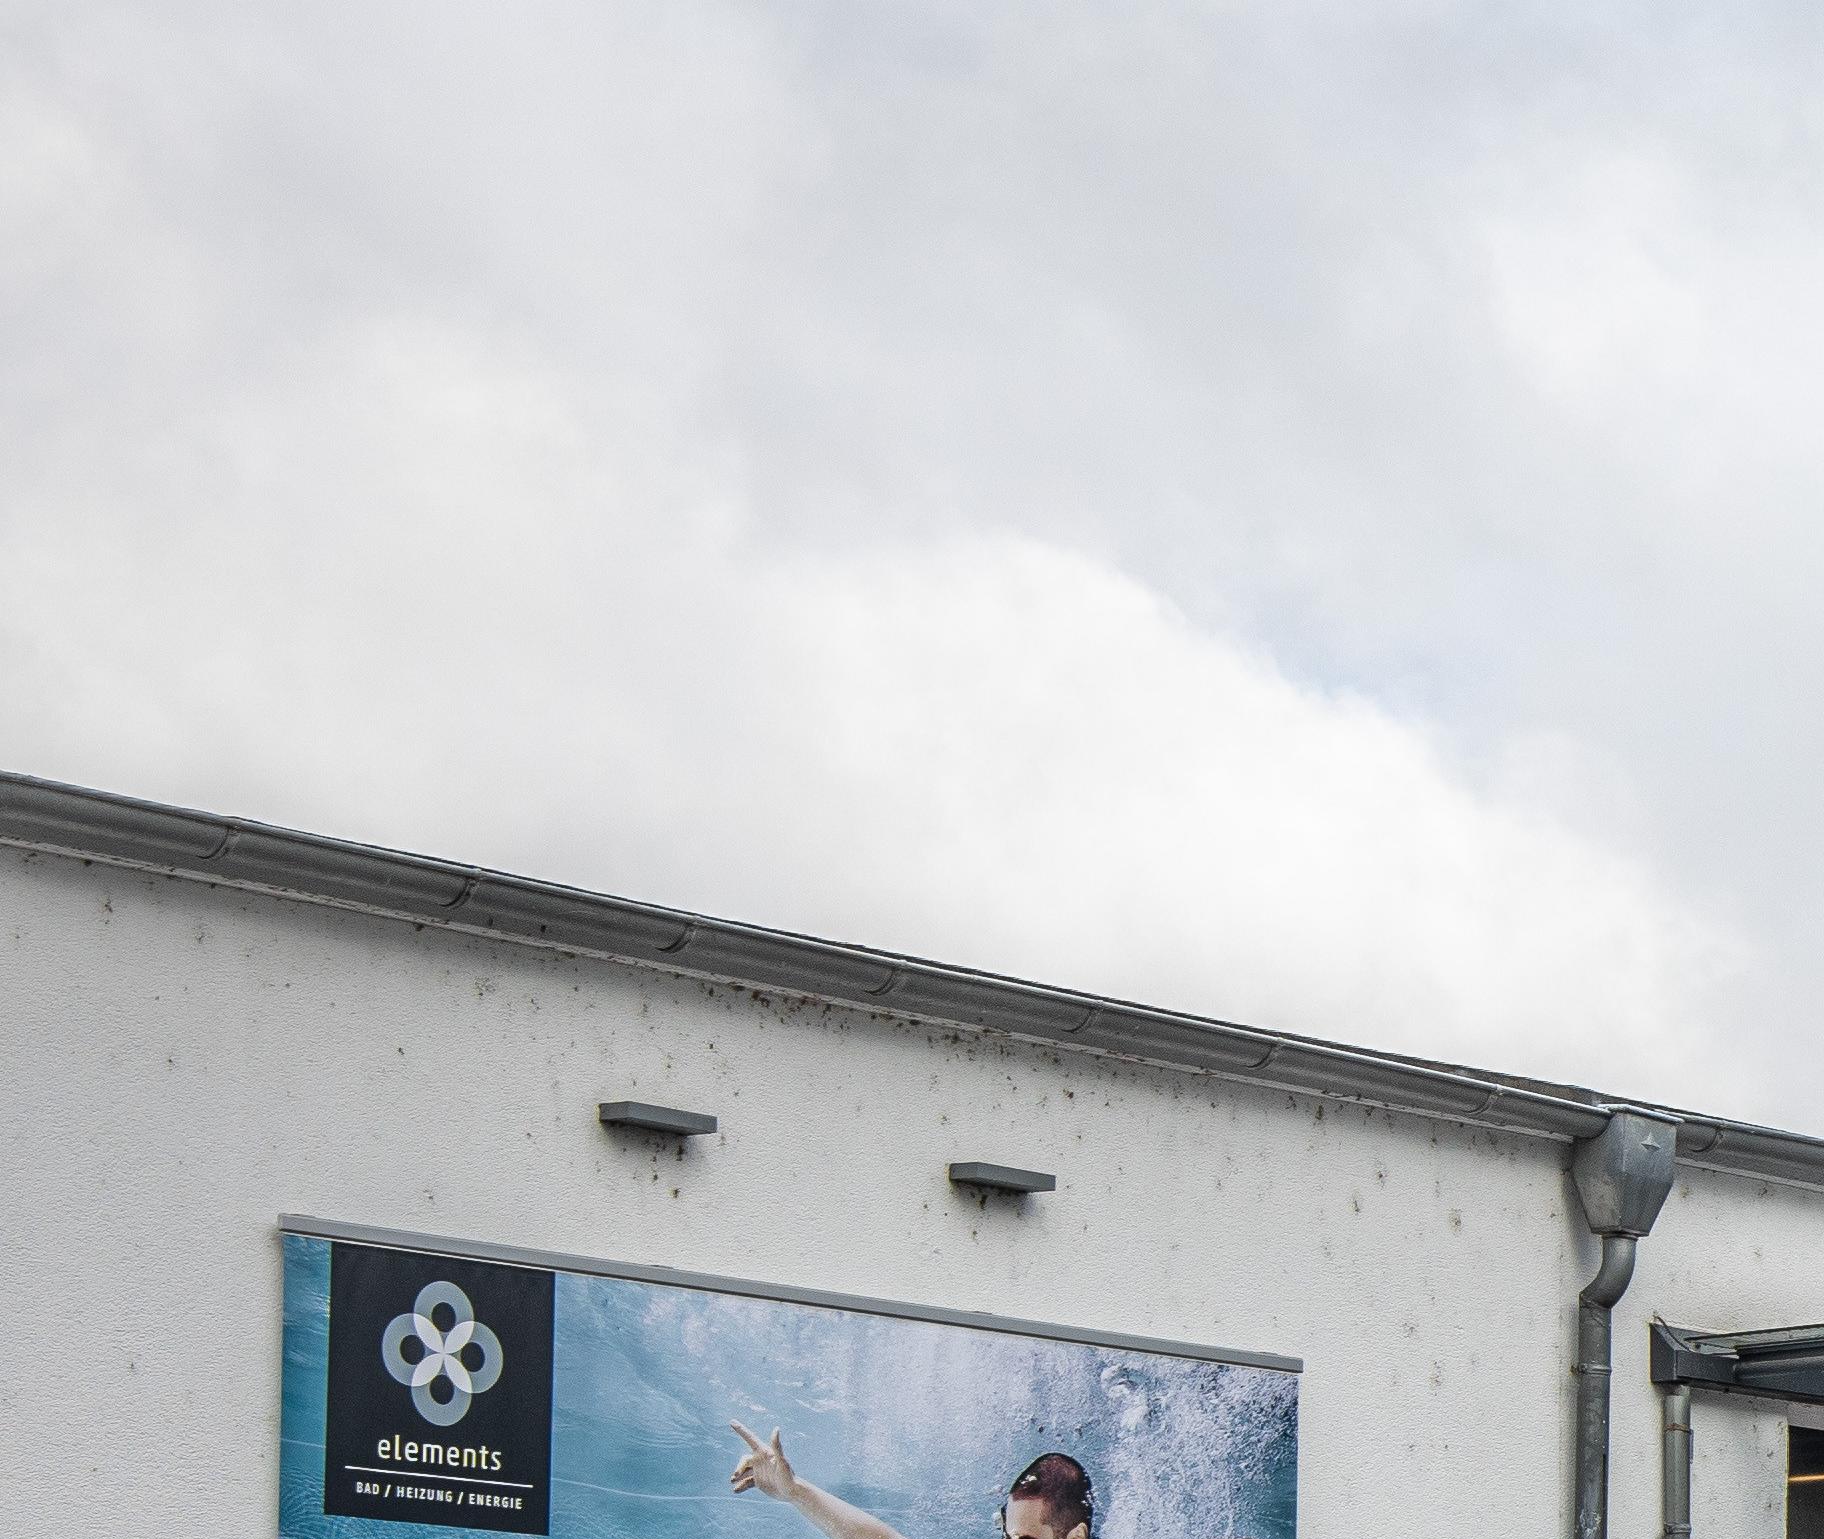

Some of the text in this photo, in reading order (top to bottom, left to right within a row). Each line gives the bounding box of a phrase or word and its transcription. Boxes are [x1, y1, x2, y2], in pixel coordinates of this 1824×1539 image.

[377, 1434, 502, 1471] elements
[356, 1481, 380, 1495] BAD
[396, 1486, 453, 1503] HEIZUNG
[468, 1493, 523, 1510] ENERGIE
